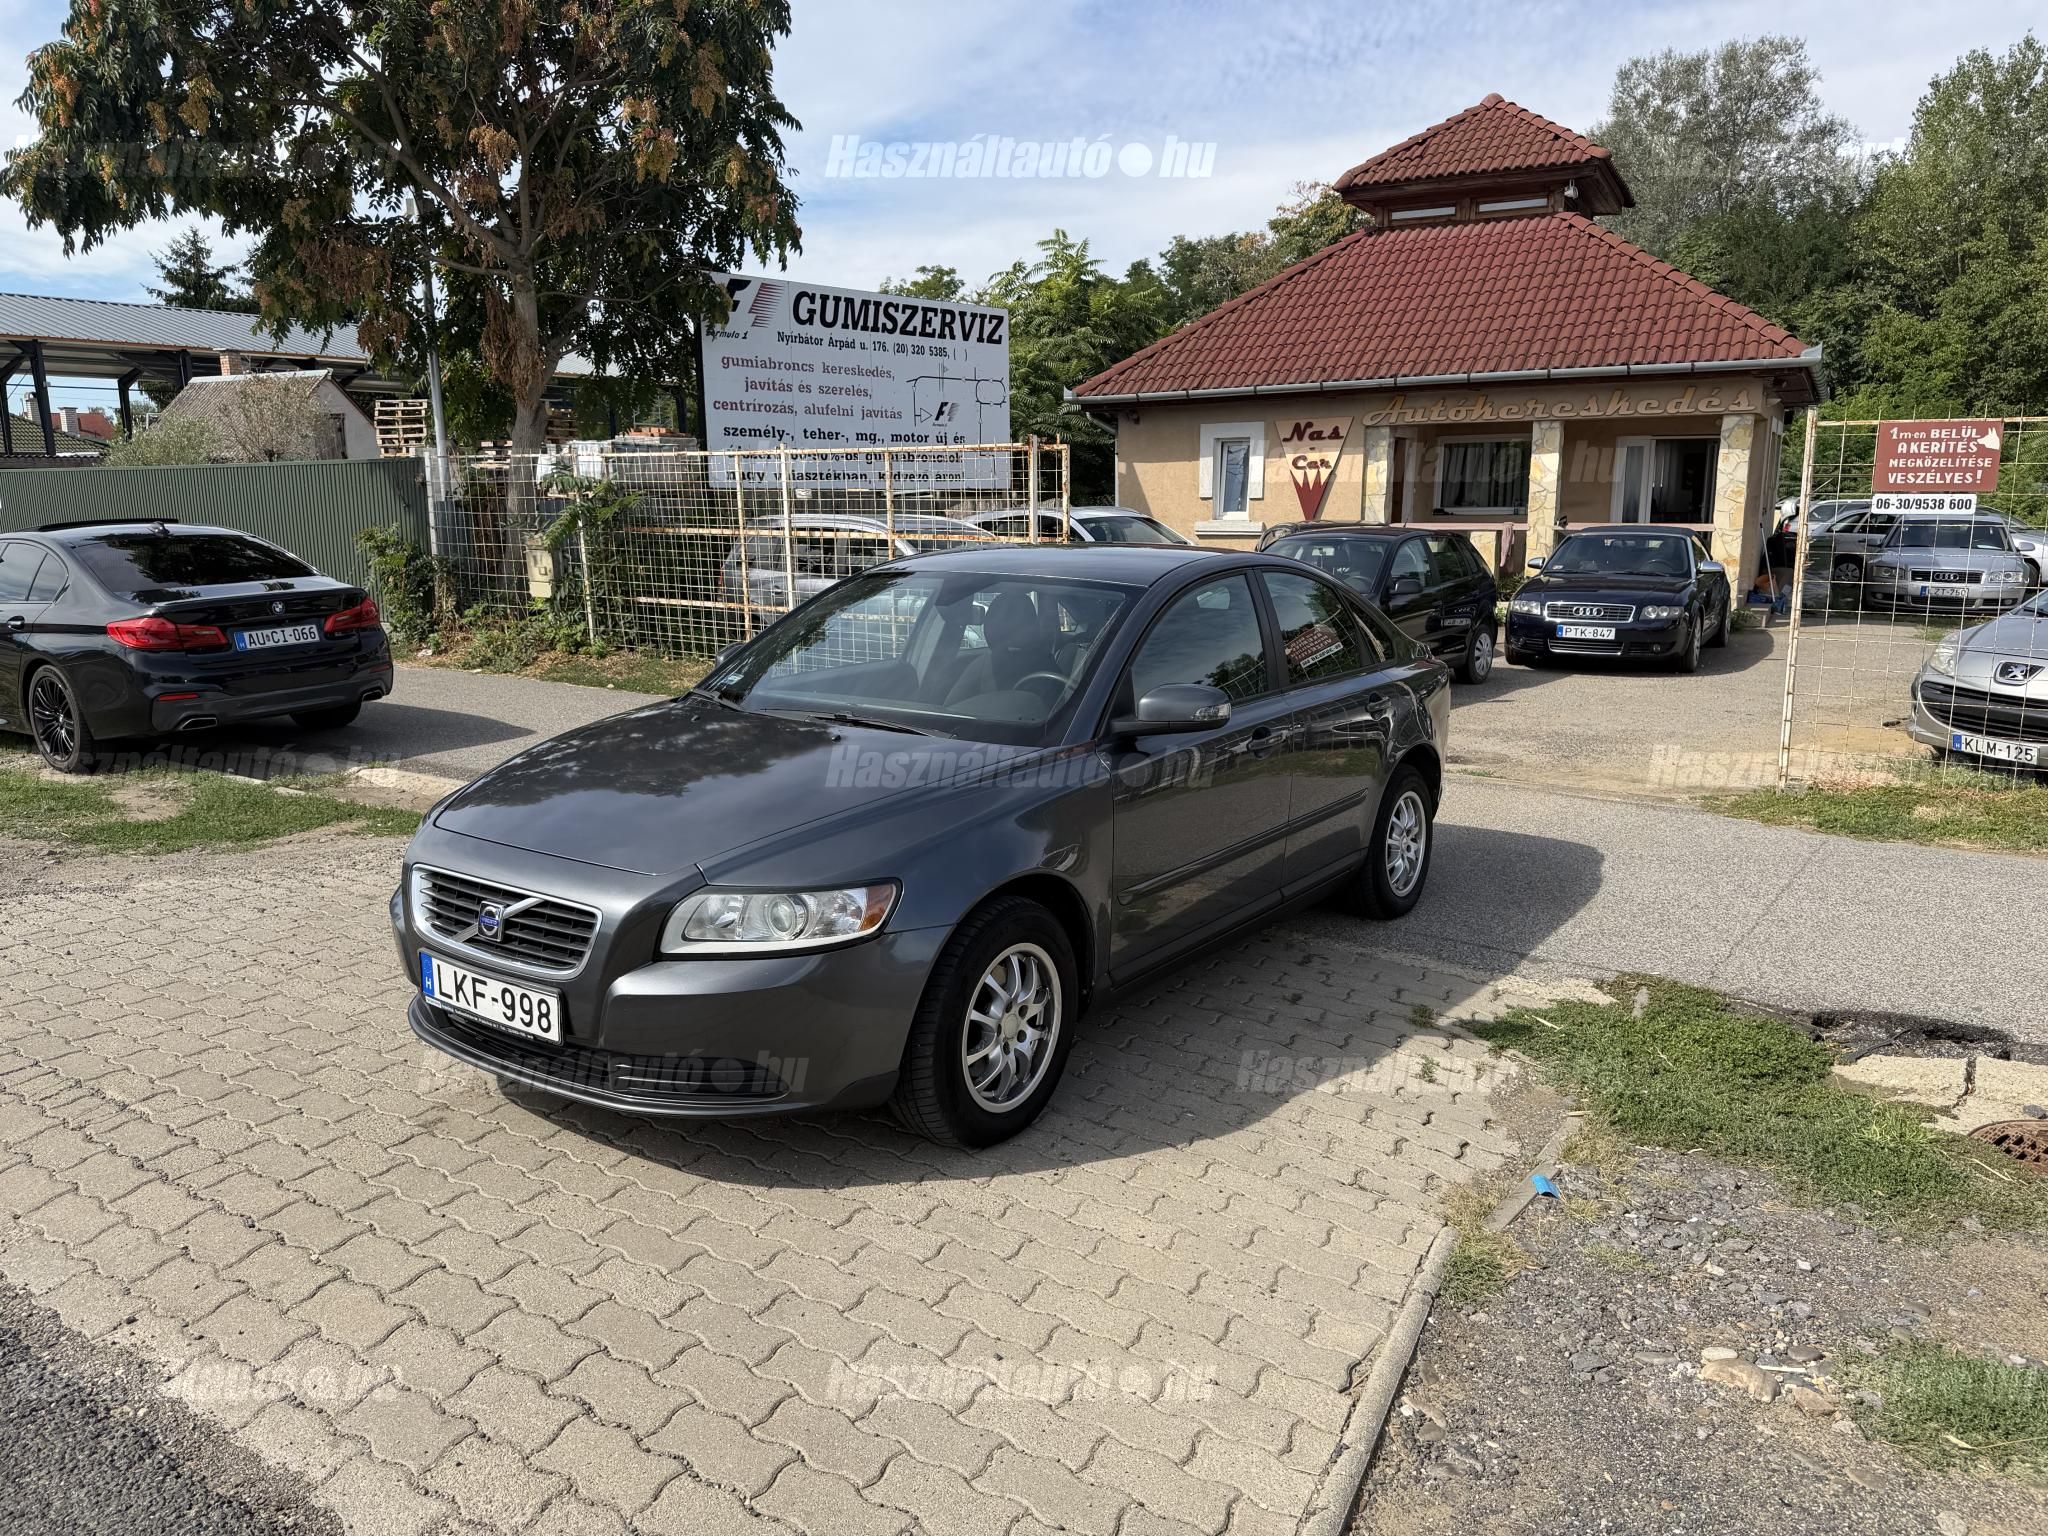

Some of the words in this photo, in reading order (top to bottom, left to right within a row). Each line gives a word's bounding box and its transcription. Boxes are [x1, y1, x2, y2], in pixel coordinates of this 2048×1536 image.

[793, 291, 1004, 344] GUMISZERVIZ
[777, 331, 824, 346] Nyírbátor
[828, 333, 855, 350] Árpád
[860, 342, 868, 350] u.
[873, 341, 889, 352] 176.
[893, 342, 909, 356] (20)
[911, 345, 925, 355] 320
[929, 346, 950, 359] 5385,
[721, 356, 814, 372] gumiabroncs
[822, 362, 895, 380] kereskedés,
[744, 377, 793, 392] javítás
[798, 380, 812, 394] és
[818, 384, 872, 399] szerelés,
[804, 403, 854, 417] alufelni
[861, 406, 903, 420] javítás
[1363, 386, 1757, 426] Autókereskedés
[723, 424, 794, 441] személy-,
[803, 428, 849, 442] teher-,
[856, 432, 884, 445] mg.,
[891, 432, 929, 443] motor
[936, 432, 948, 445] új
[953, 432, 966, 443] és
[1282, 421, 1344, 442] Nas
[1930, 426, 1981, 438] BELÜL
[1910, 439, 1978, 453] KERÍTÉS
[1291, 454, 1332, 470] Car
[1888, 455, 1993, 468] MEGKÖZELÍTÉSE
[1876, 498, 1945, 510] 06-30/9538
[1949, 498, 1972, 510] 600
[1565, 627, 1612, 638] PTK-847
[1965, 737, 2033, 762] KLM-125
[437, 964, 551, 1033] LKF-998
